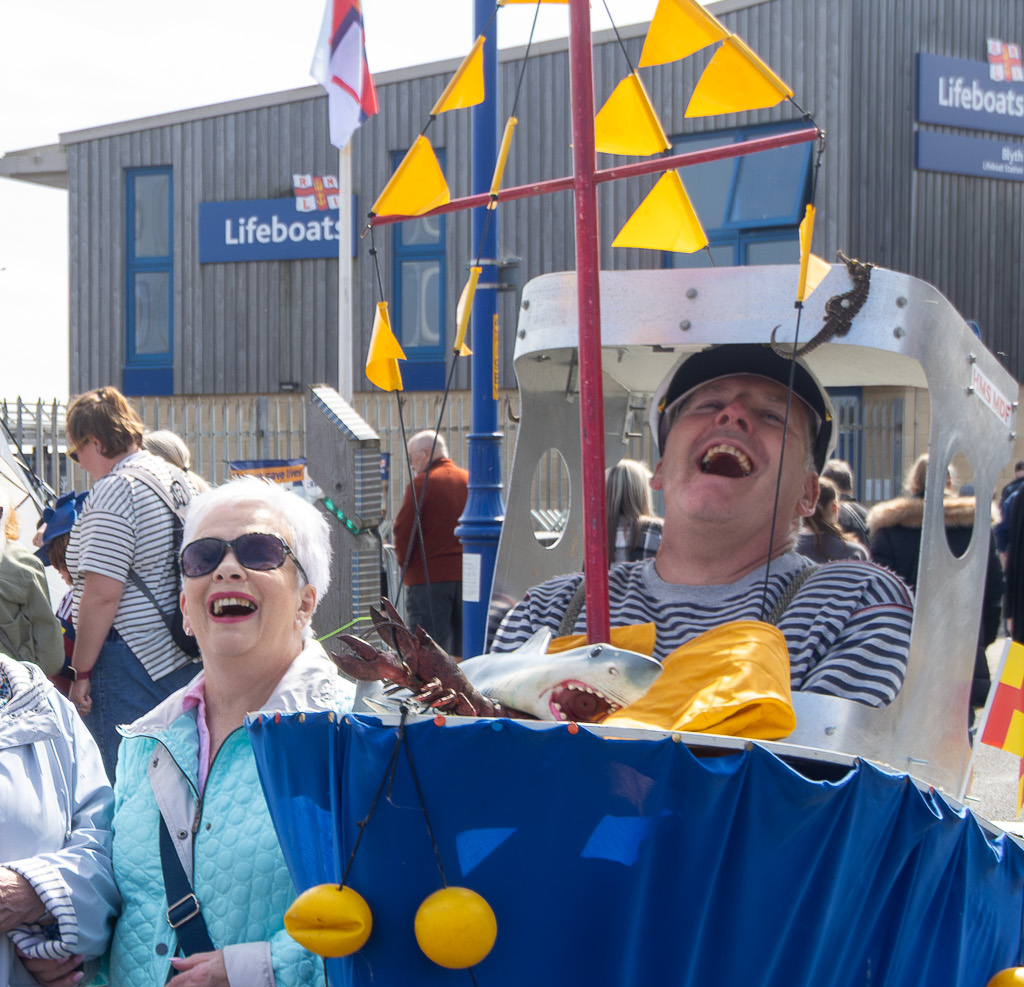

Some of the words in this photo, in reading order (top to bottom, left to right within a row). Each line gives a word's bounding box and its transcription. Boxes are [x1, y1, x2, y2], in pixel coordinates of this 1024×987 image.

[938, 76, 1024, 117] Lifeboats
[1001, 147, 1023, 165] Blyth
[973, 368, 992, 404] HMS
[992, 391, 1011, 422] MDF
[286, 469, 302, 479] lives
